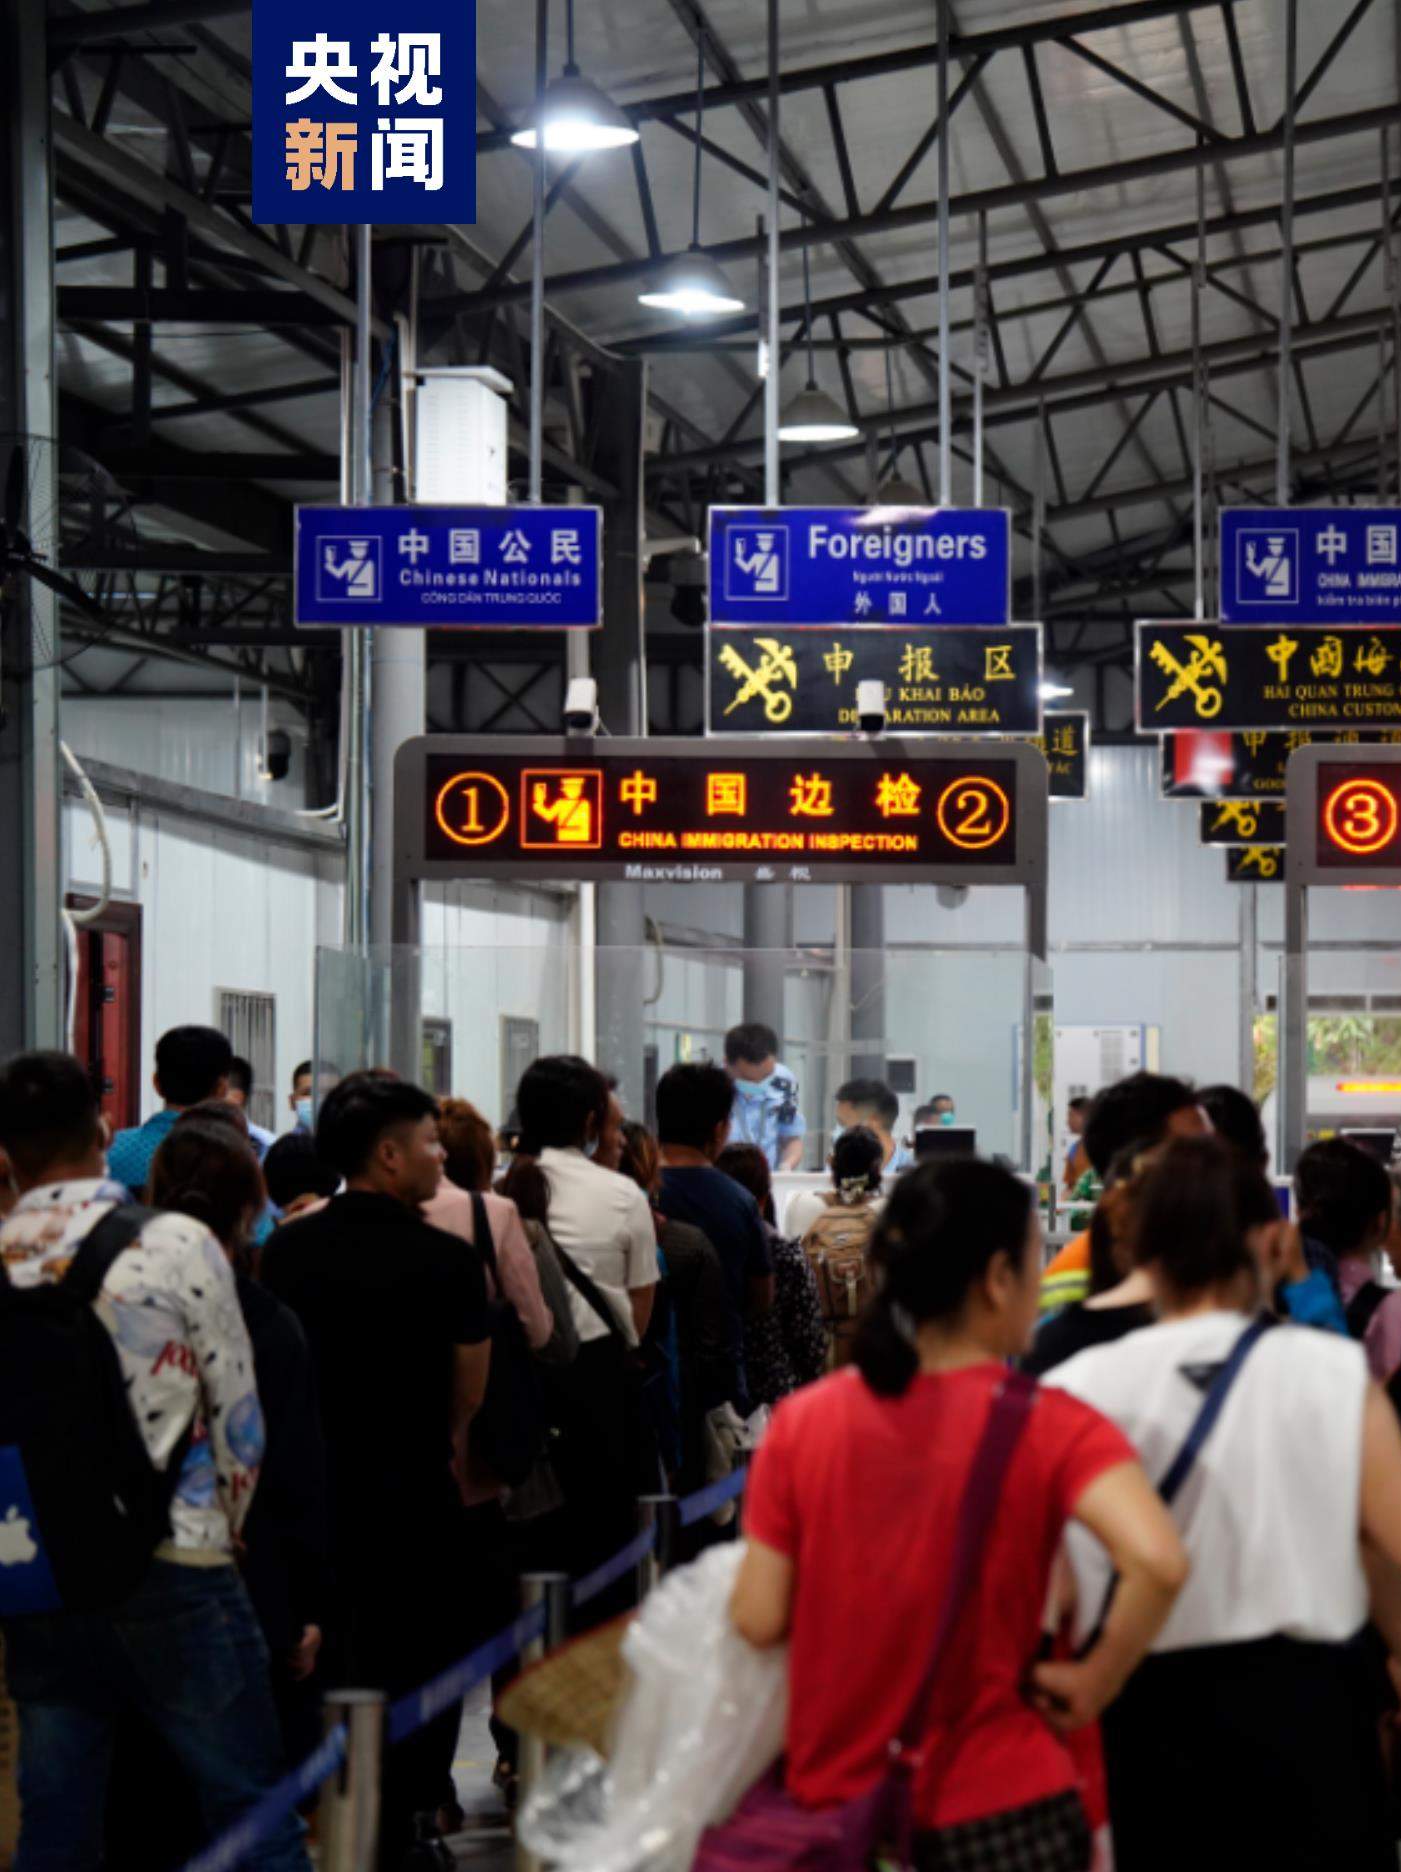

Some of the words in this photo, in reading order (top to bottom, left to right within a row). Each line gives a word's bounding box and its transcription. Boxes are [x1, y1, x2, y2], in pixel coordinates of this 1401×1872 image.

[398, 528, 582, 565] 中国公民
[809, 524, 987, 567] Foreigners
[400, 569, 479, 586] Chinese
[483, 569, 581, 586] Nationals
[1317, 573, 1351, 588] CHINA
[854, 591, 942, 616] 外国人
[823, 642, 1016, 686] 申报区
[900, 687, 941, 702] KHAI
[1295, 684, 1337, 699] QUAN
[1344, 684, 1393, 699] TRUNG
[838, 708, 949, 724] DEARATION
[958, 708, 1000, 723] AREA
[1288, 703, 1338, 718] CHINA
[620, 769, 922, 816] 中国边检
[619, 831, 677, 849] CHINA
[681, 832, 804, 850] IMMIGRATION
[809, 833, 918, 850] INSPECTION
[625, 863, 722, 880] Maxvision
